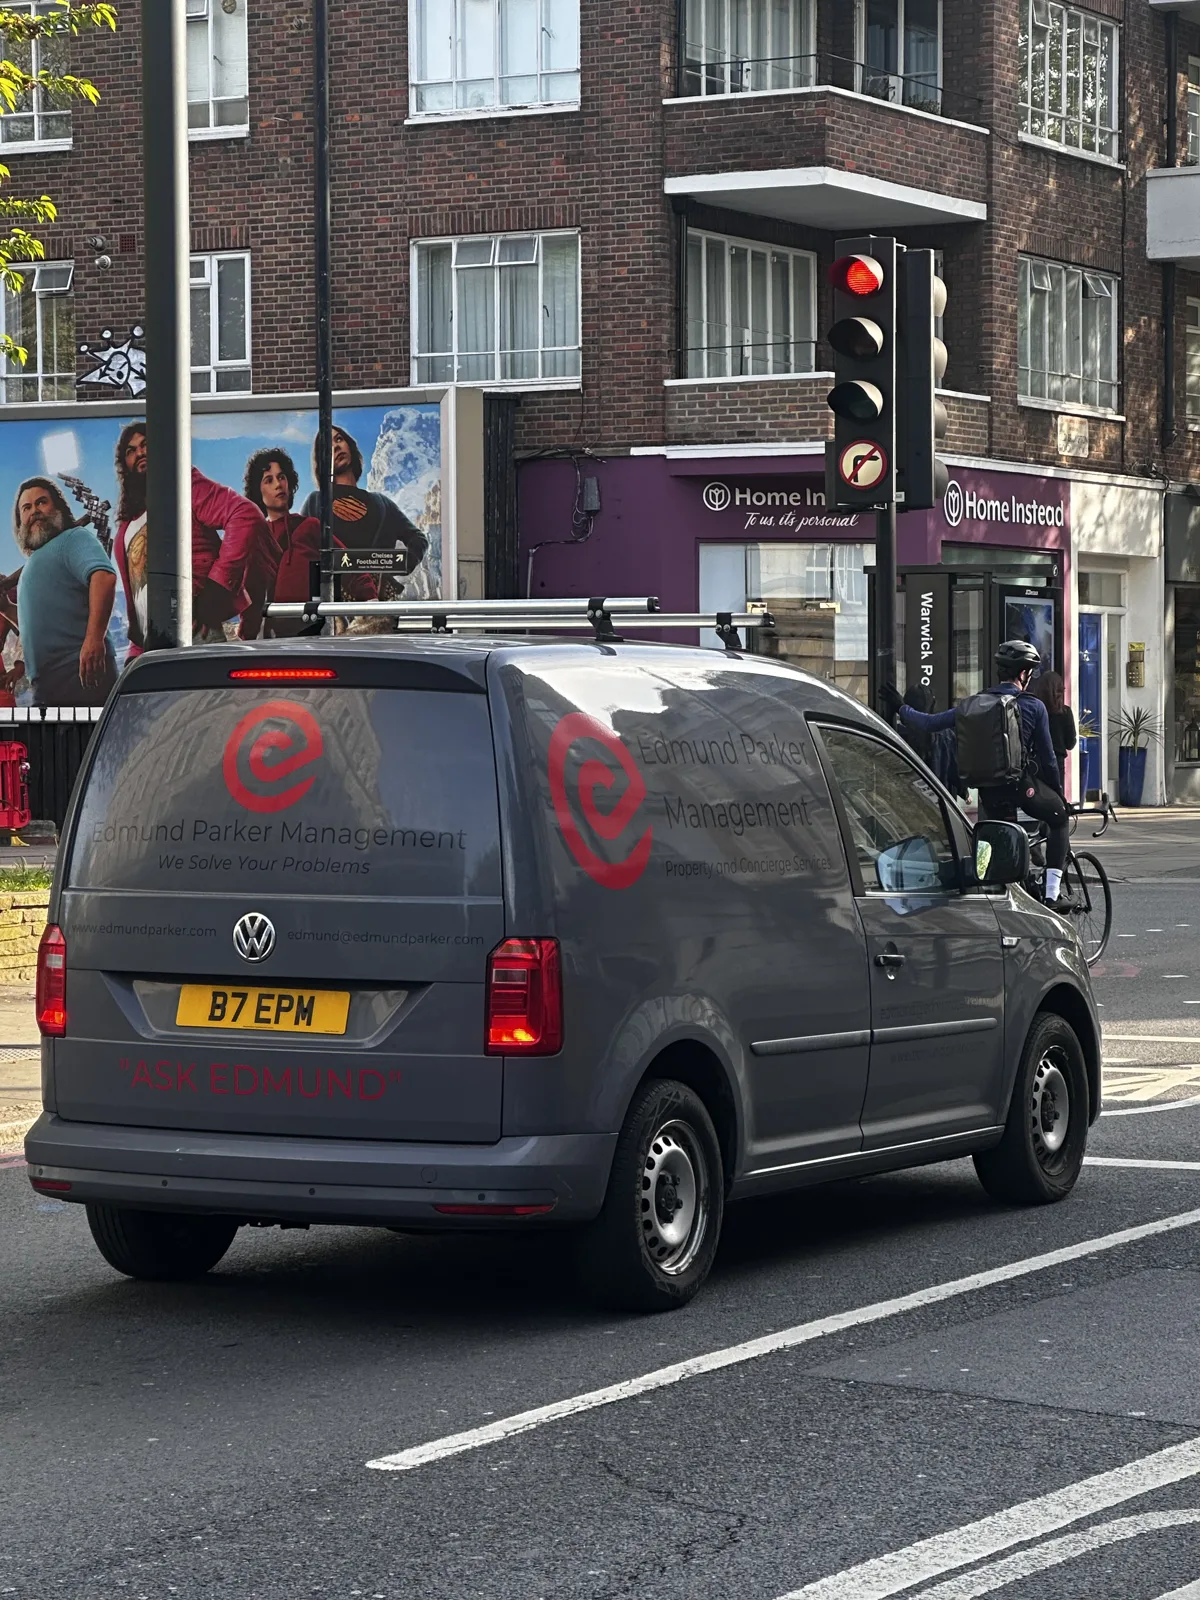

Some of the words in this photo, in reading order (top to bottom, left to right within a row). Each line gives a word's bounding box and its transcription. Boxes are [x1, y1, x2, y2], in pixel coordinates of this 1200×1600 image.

[735, 487, 801, 506] Home
[965, 490, 1010, 522] Home
[1011, 495, 1065, 527] Instead
[744, 511, 760, 530] To
[759, 515, 776, 527] us,
[794, 513, 860, 533] personal
[920, 591, 934, 660] Warwick
[637, 731, 739, 765] Edmund
[740, 733, 808, 765] Parker
[663, 795, 813, 837] Management
[92, 818, 185, 843] Edmund
[192, 818, 273, 843] Parker
[280, 820, 468, 851] Management
[158, 854, 184, 870] We
[188, 854, 232, 871] Solve
[238, 855, 278, 872] Your
[282, 855, 371, 875] Problems
[665, 859, 714, 880] Property
[716, 856, 738, 875] and
[739, 855, 792, 874] Concierge
[793, 853, 832, 871] Services
[71, 922, 218, 938] www.edmundparker.com
[287, 928, 485, 946] edmund@edmundparker.com
[208, 991, 249, 1023] B7
[254, 993, 316, 1027] EPM
[119, 1057, 198, 1093] "ASK
[209, 1062, 403, 1101] EDMUND"
